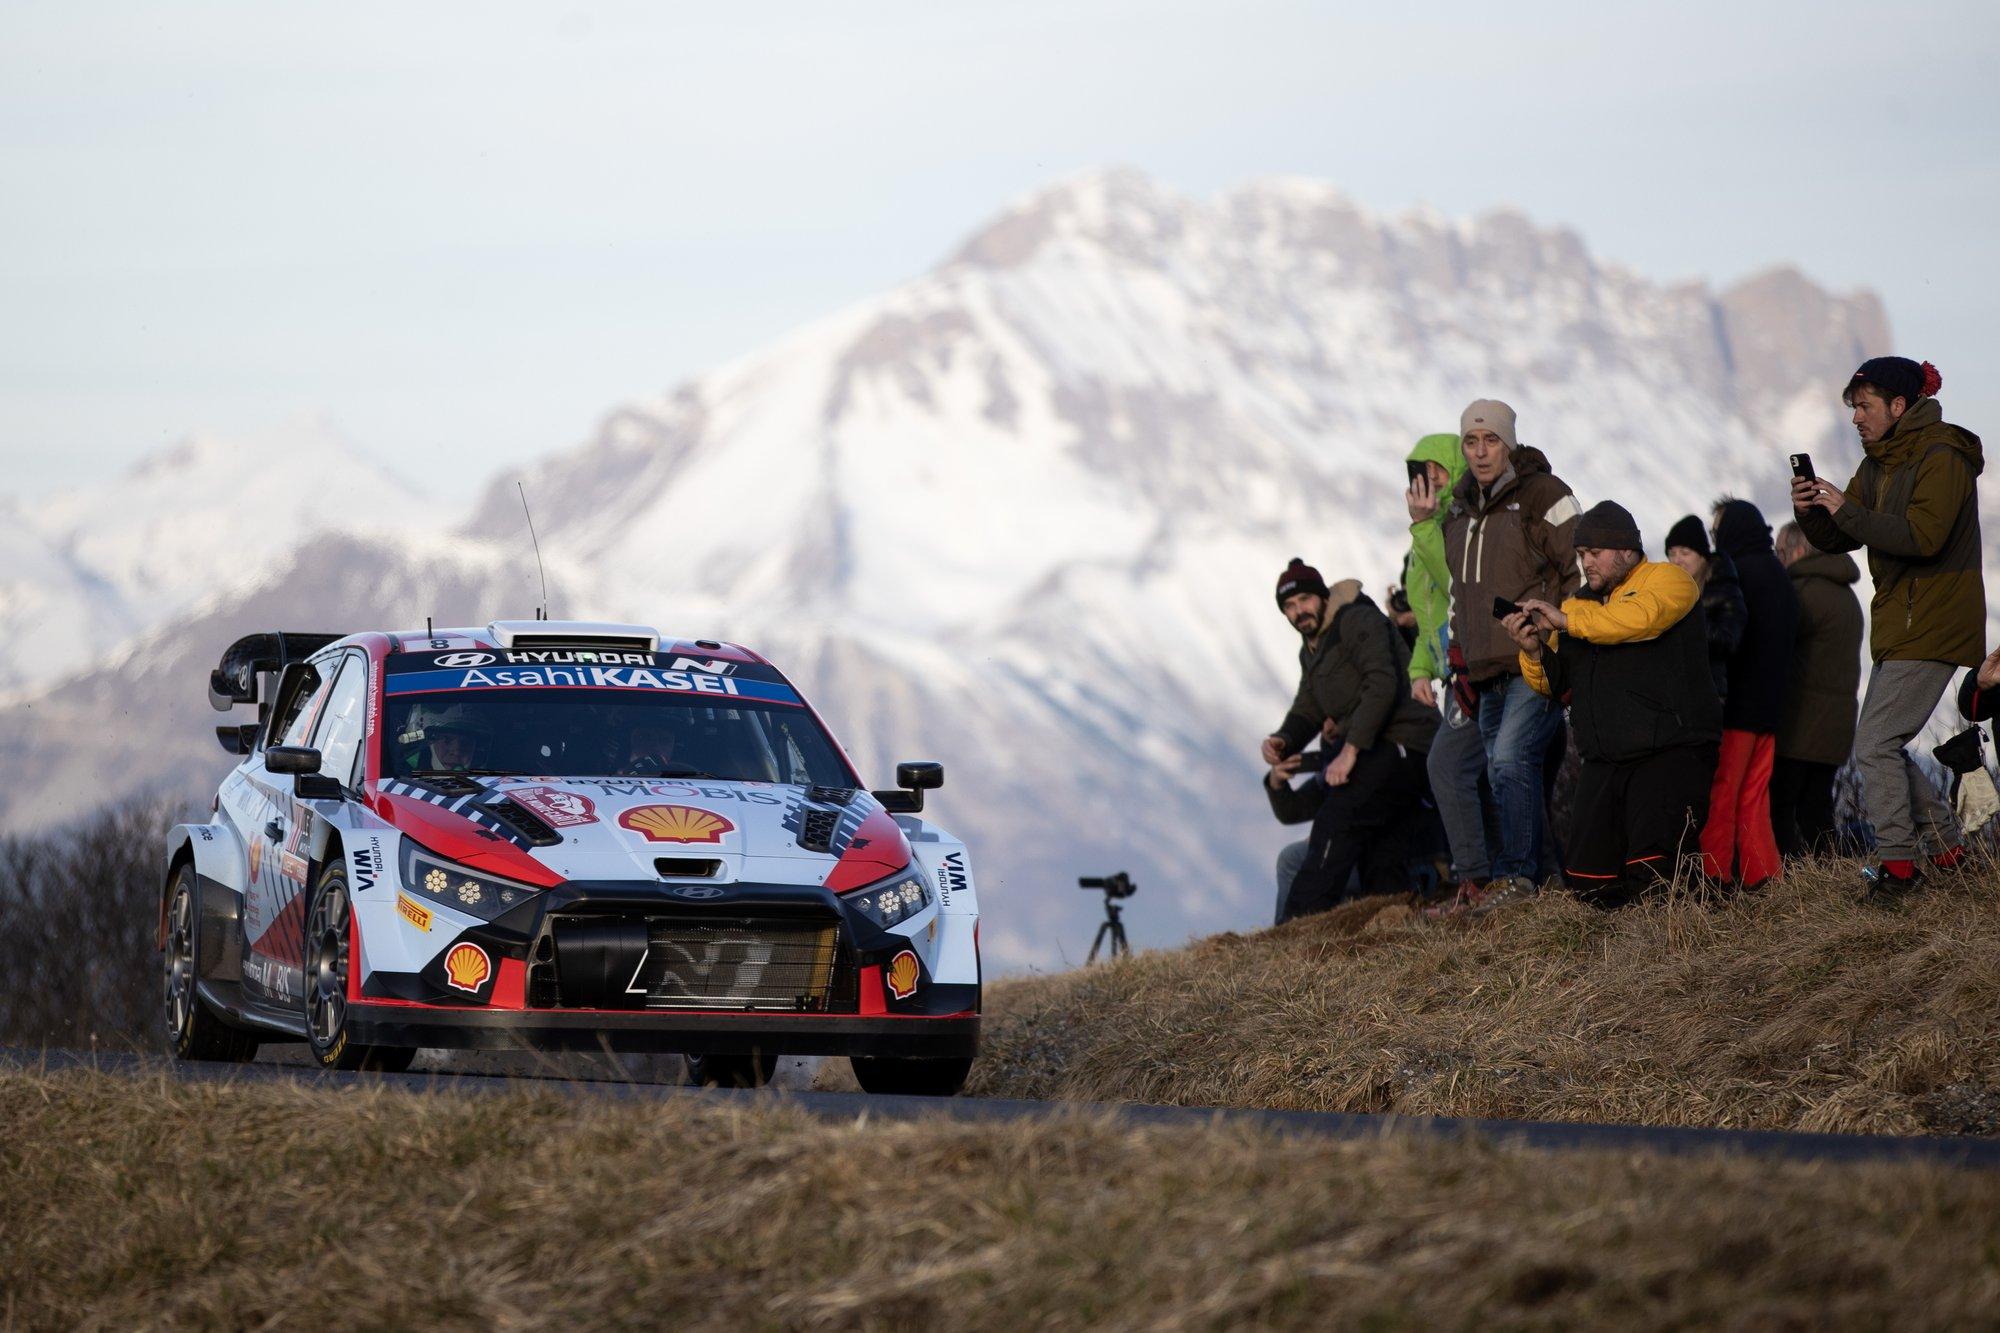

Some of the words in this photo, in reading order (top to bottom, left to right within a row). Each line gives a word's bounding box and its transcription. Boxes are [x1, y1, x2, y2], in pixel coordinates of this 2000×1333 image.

[430, 639, 450, 649] 8
[505, 651, 655, 666] HYUNDAI
[600, 784, 782, 805] MOBIS
[353, 849, 375, 892] WIA
[370, 836, 383, 872] HYUNDAI
[945, 851, 967, 891] WIA
[937, 868, 951, 906] HYUNDAI
[397, 894, 429, 927] PIRELLI
